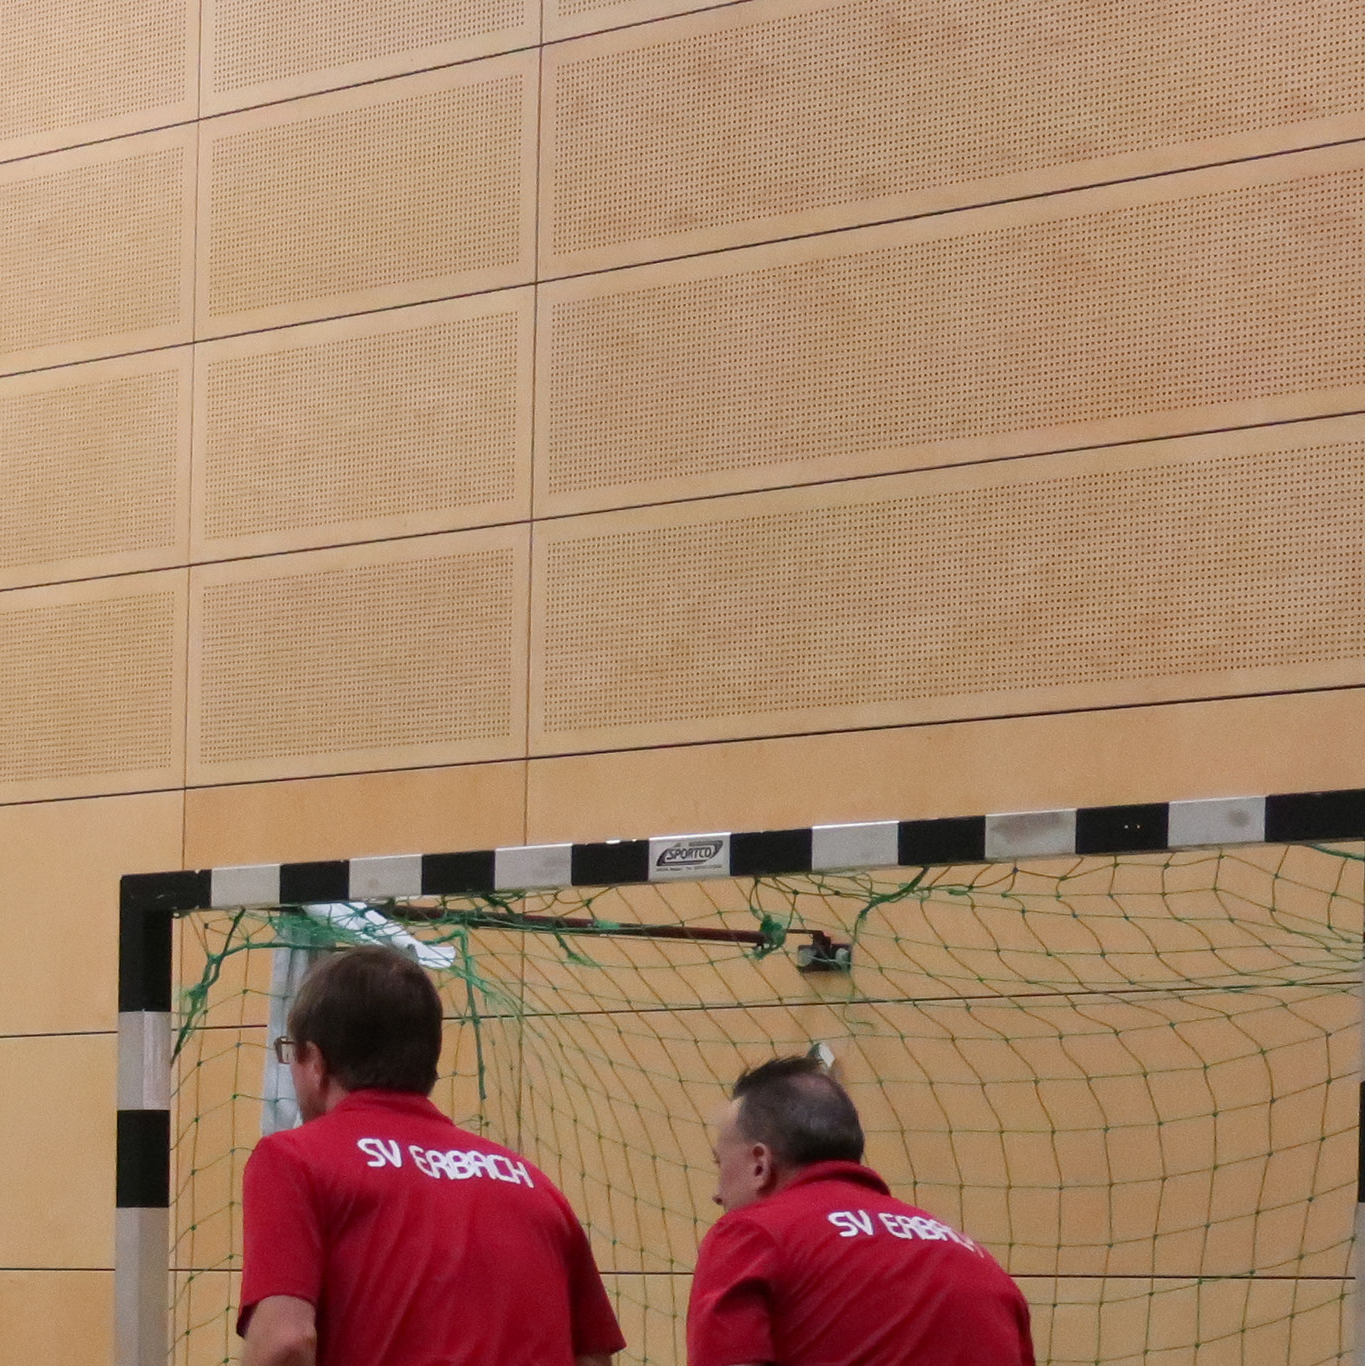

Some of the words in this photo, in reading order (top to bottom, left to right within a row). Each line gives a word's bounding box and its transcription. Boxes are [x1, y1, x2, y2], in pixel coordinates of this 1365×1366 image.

[356, 1137, 402, 1168] SV
[407, 1144, 535, 1189] ERBACH
[827, 1209, 875, 1238] SV
